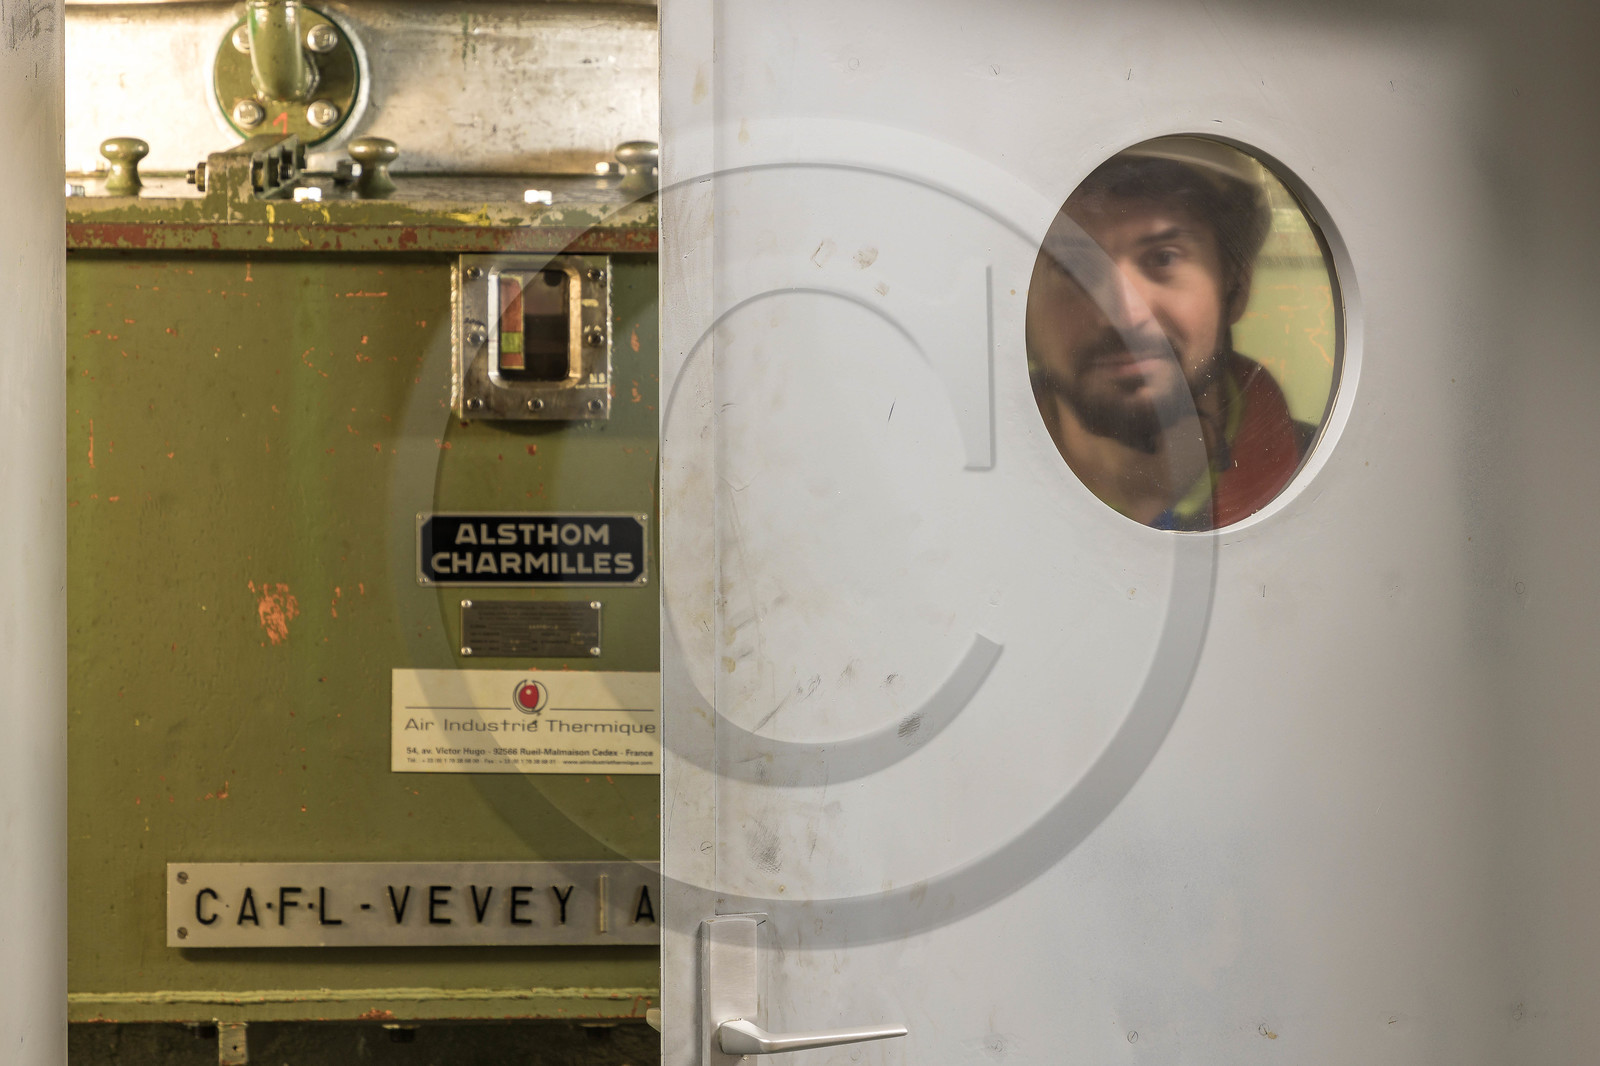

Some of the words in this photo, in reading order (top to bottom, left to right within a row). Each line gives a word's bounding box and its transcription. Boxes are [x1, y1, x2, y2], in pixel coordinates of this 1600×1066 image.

[454, 523, 610, 546] ALSTHOM
[431, 552, 634, 575] CHARMILLES
[404, 718, 435, 731] Air
[443, 718, 538, 733] Industrie
[545, 719, 656, 736] Thermique
[435, 747, 461, 755] Victor
[462, 747, 486, 757] Hugo
[520, 748, 590, 757] Rueil-Malmaison
[592, 748, 618, 757] Cedex
[625, 748, 654, 757] France
[387, 884, 575, 925] VEVEY
